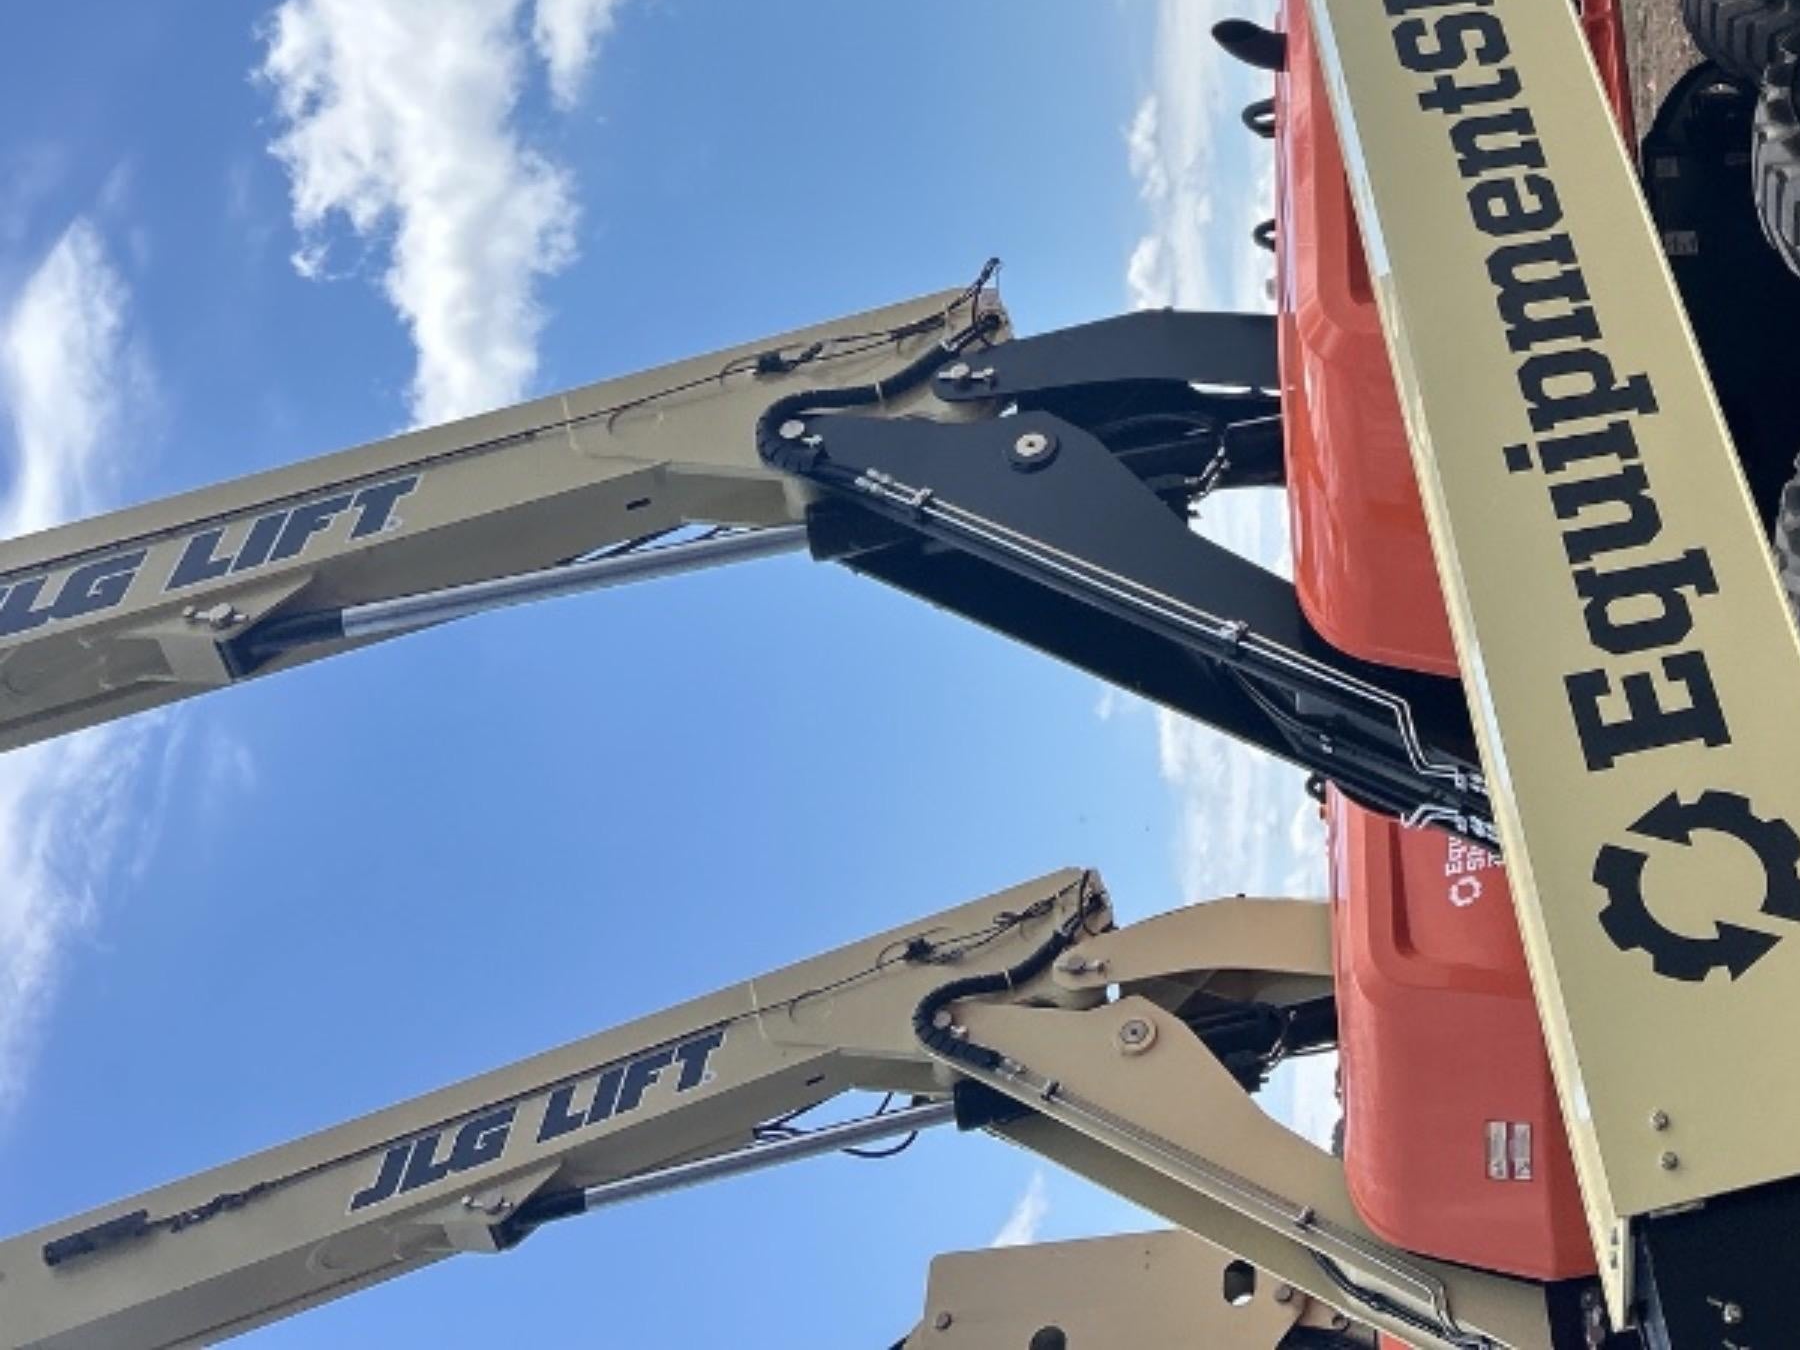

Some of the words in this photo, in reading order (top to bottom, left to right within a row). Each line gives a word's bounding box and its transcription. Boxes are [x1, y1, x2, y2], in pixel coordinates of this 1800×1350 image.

[0, 550, 149, 637] LG
[163, 473, 424, 593] LIFT
[345, 1102, 519, 1216] JLG
[536, 1029, 729, 1145] LIFT
